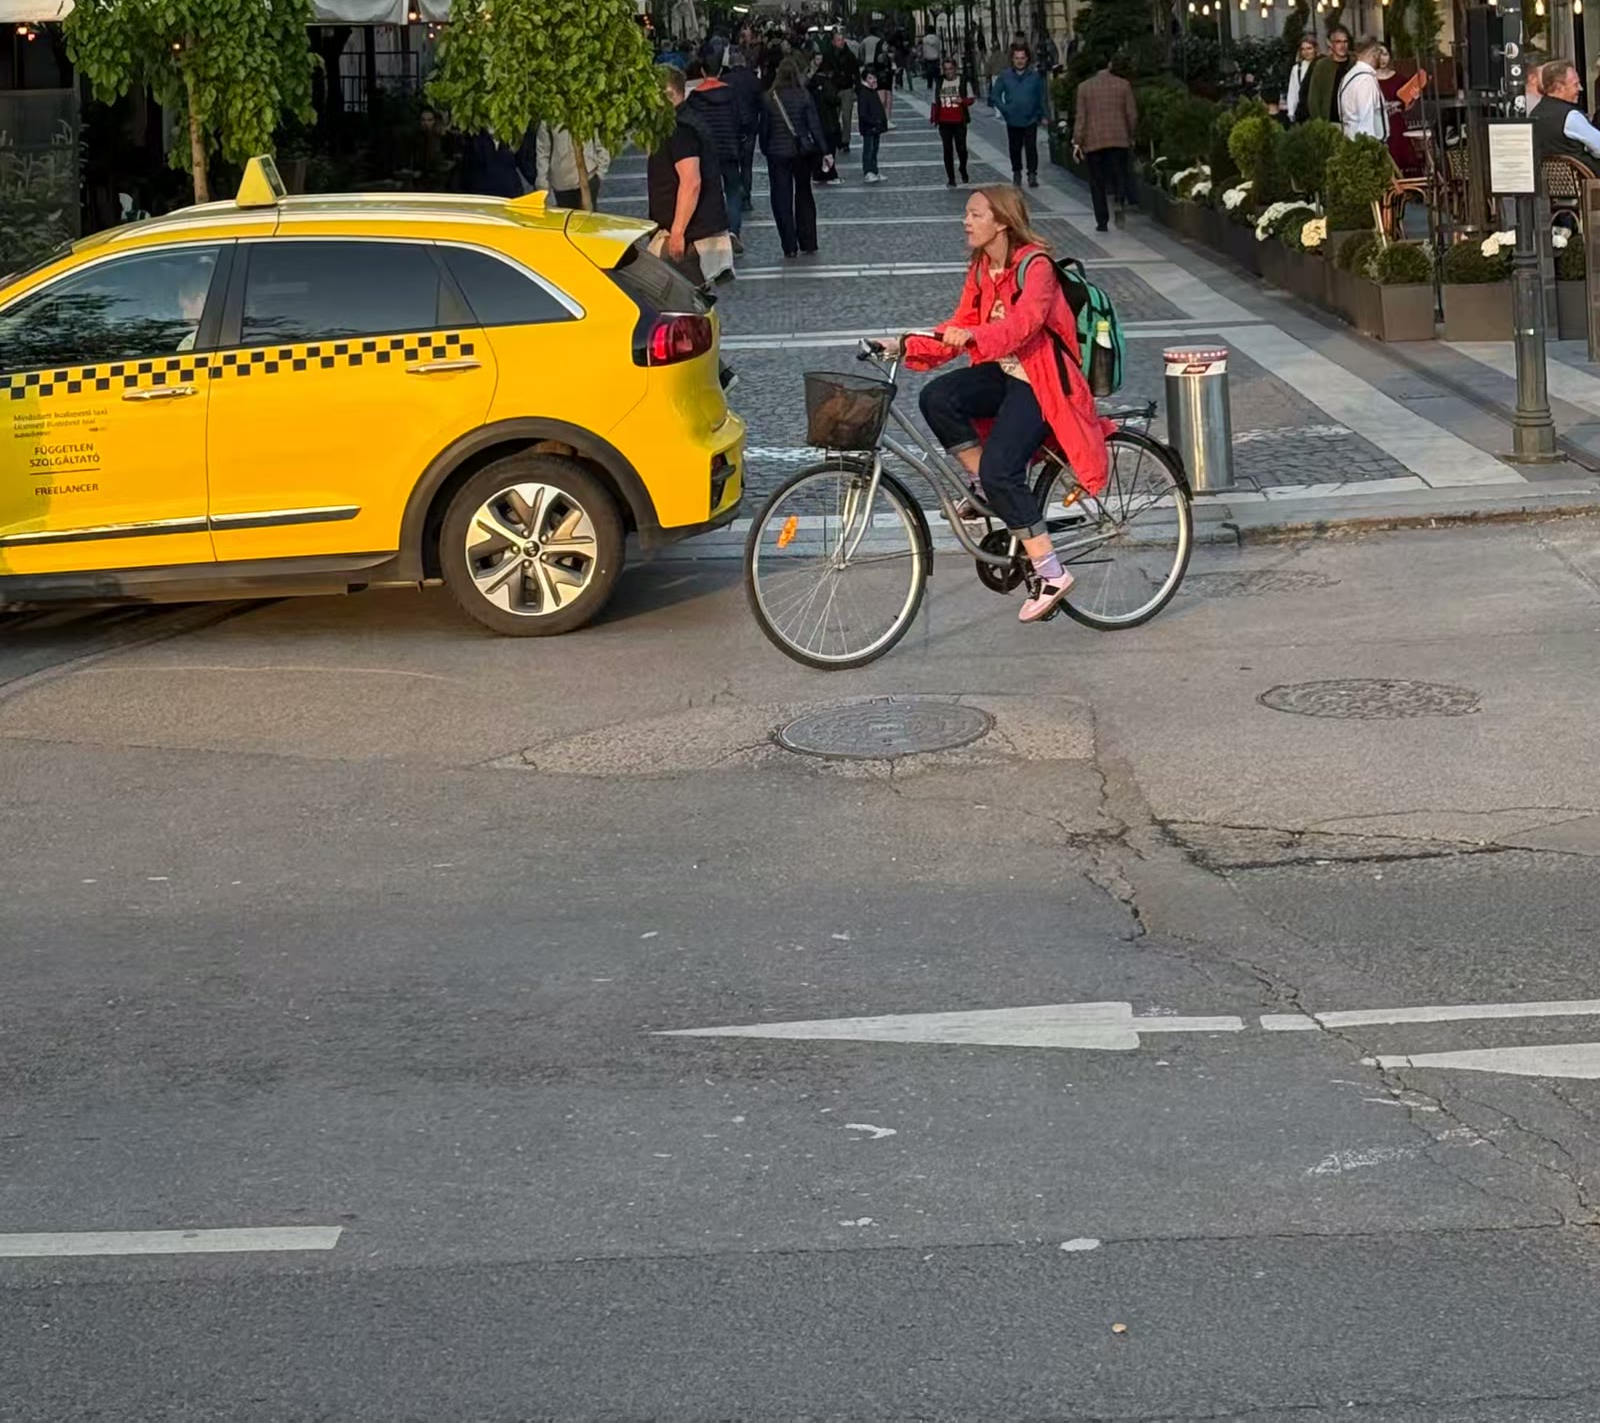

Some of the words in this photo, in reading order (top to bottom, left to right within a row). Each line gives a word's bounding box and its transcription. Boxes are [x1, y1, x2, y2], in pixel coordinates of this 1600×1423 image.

[34, 443, 94, 455] FÜGGETLEN
[29, 453, 100, 468] SZOLGÁLTATÓ
[35, 483, 100, 496] FREELANCER
